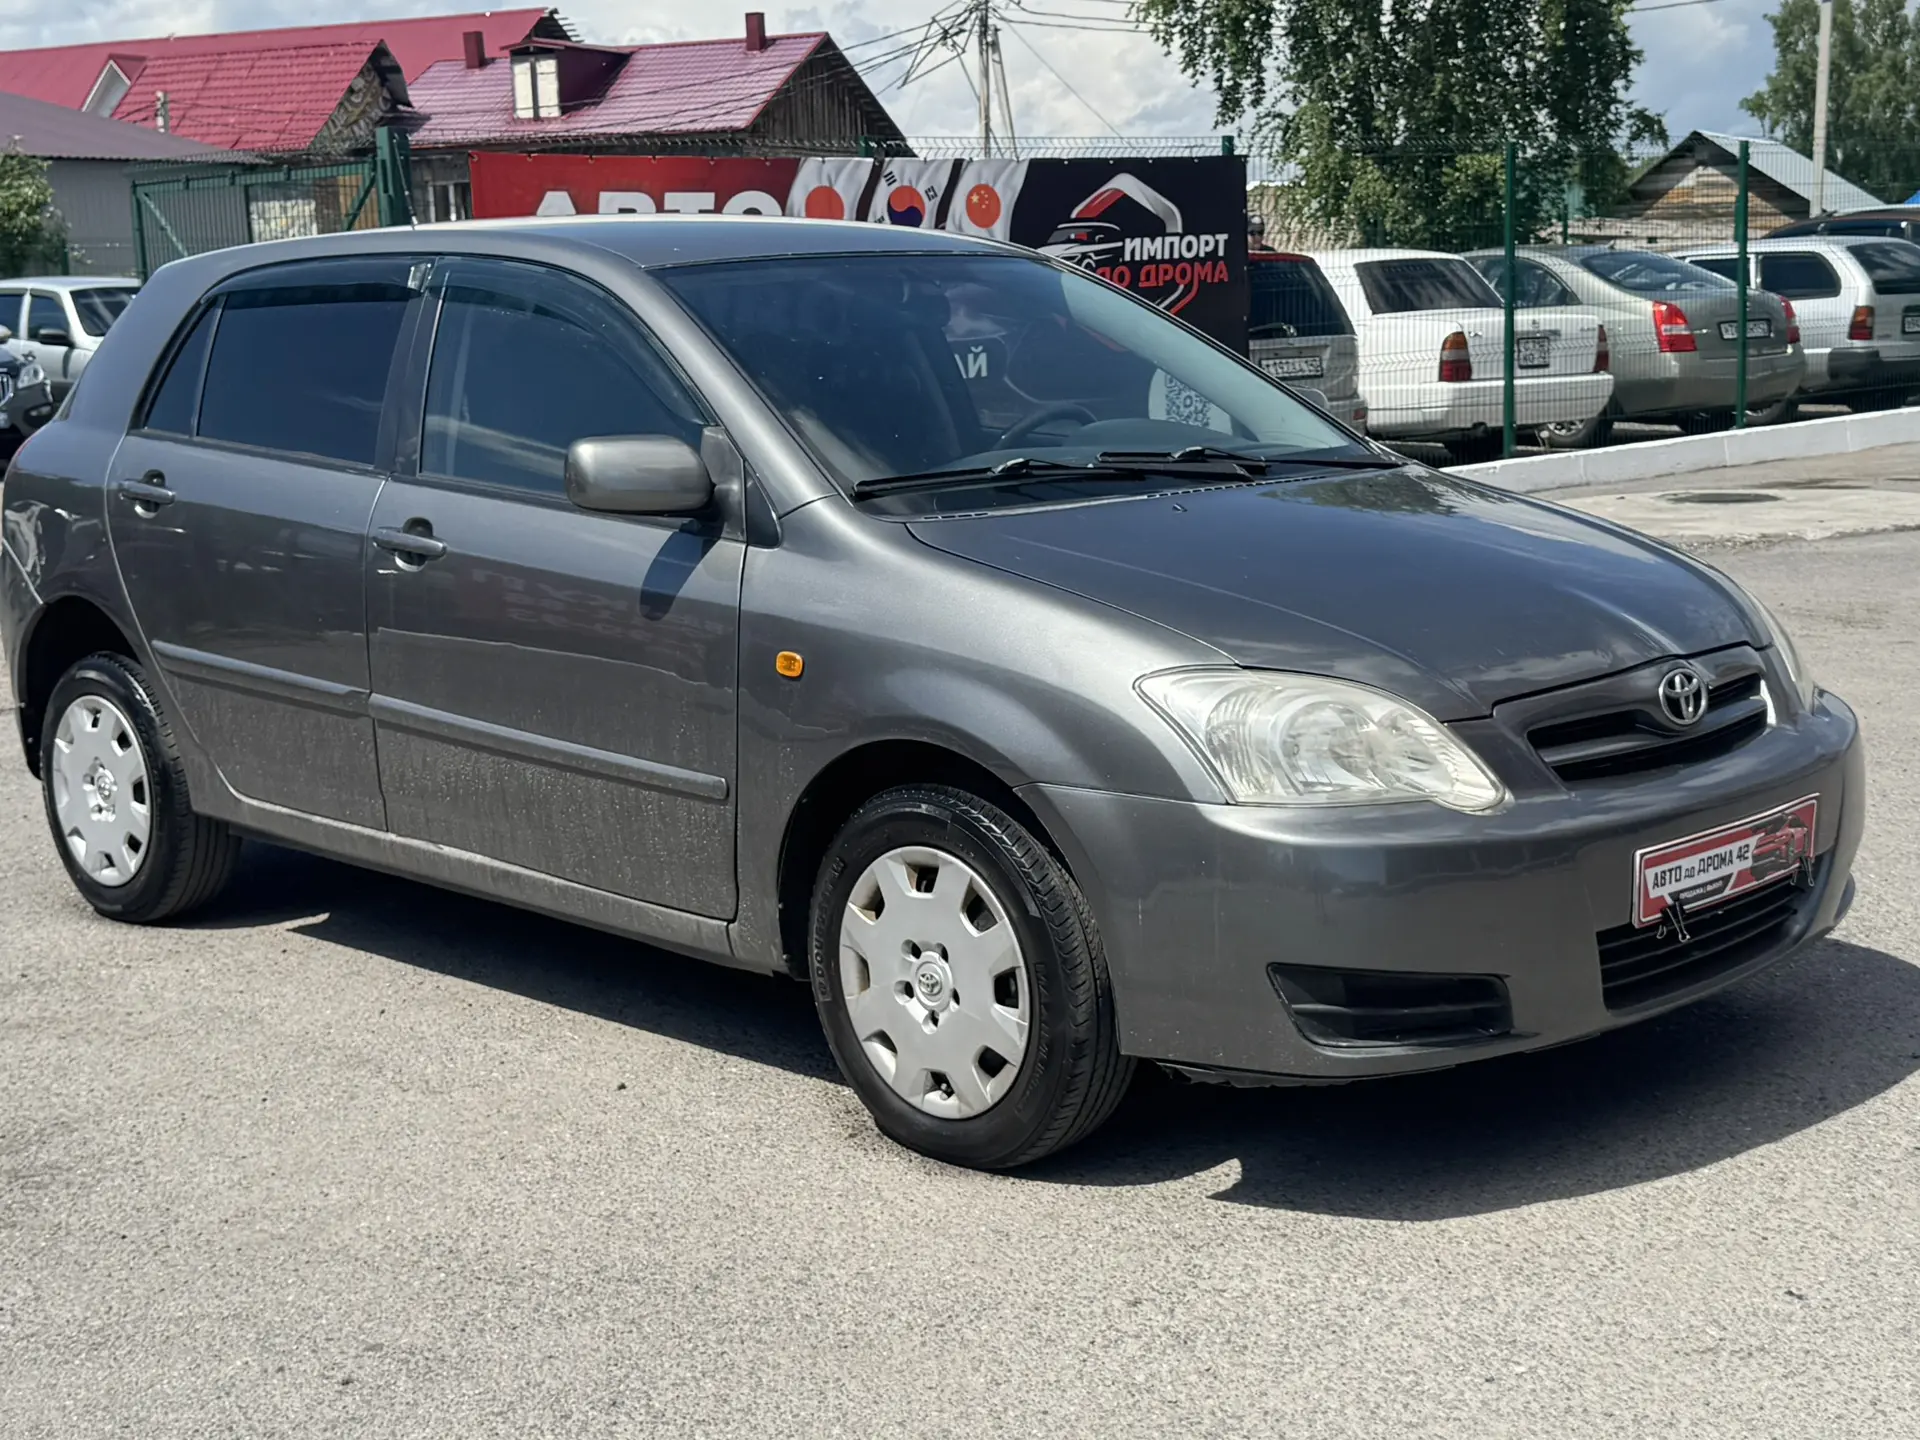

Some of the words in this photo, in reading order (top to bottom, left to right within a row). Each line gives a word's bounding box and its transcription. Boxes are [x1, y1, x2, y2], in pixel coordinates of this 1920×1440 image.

[1124, 234, 1229, 261] ИМПОРТ
[1138, 260, 1229, 288] ДРОМА
[1652, 865, 1682, 890] АВТО
[1697, 849, 1734, 875] ДРОМА
[1736, 844, 1750, 862] 42
